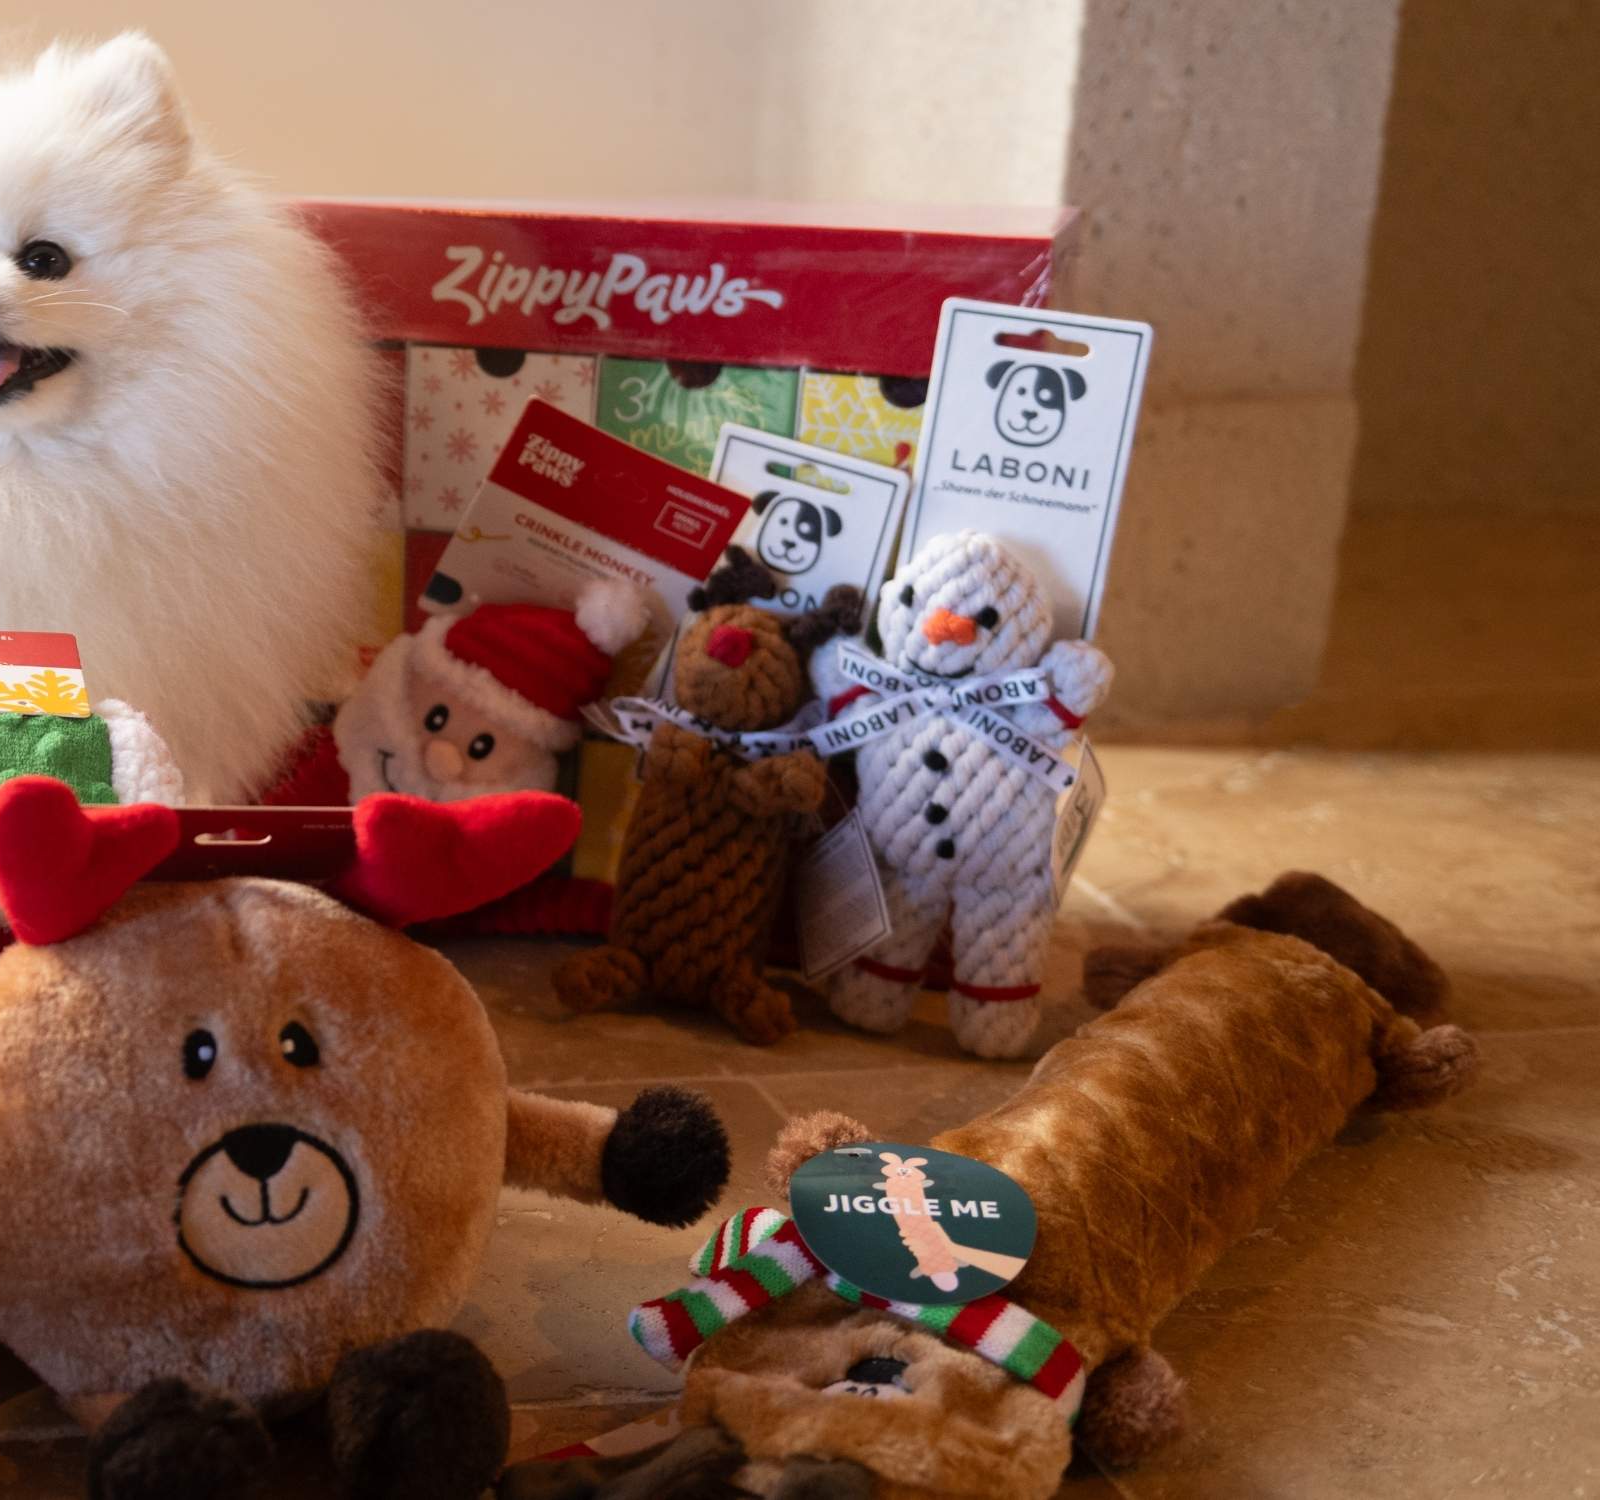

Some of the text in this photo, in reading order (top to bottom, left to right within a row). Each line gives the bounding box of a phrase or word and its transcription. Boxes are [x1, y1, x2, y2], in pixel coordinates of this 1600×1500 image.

[431, 245, 783, 330] ZippyPaws
[517, 451, 574, 488] Paws
[527, 433, 586, 473] Zippy
[951, 449, 1090, 490] LABONI
[984, 486, 1005, 499] der
[514, 512, 583, 553] CRINKLE
[583, 546, 656, 587] MONKEY
[825, 702, 916, 748] LABONI
[968, 710, 1059, 775] LABONI
[824, 1194, 1000, 1219] JIGGLE ME
